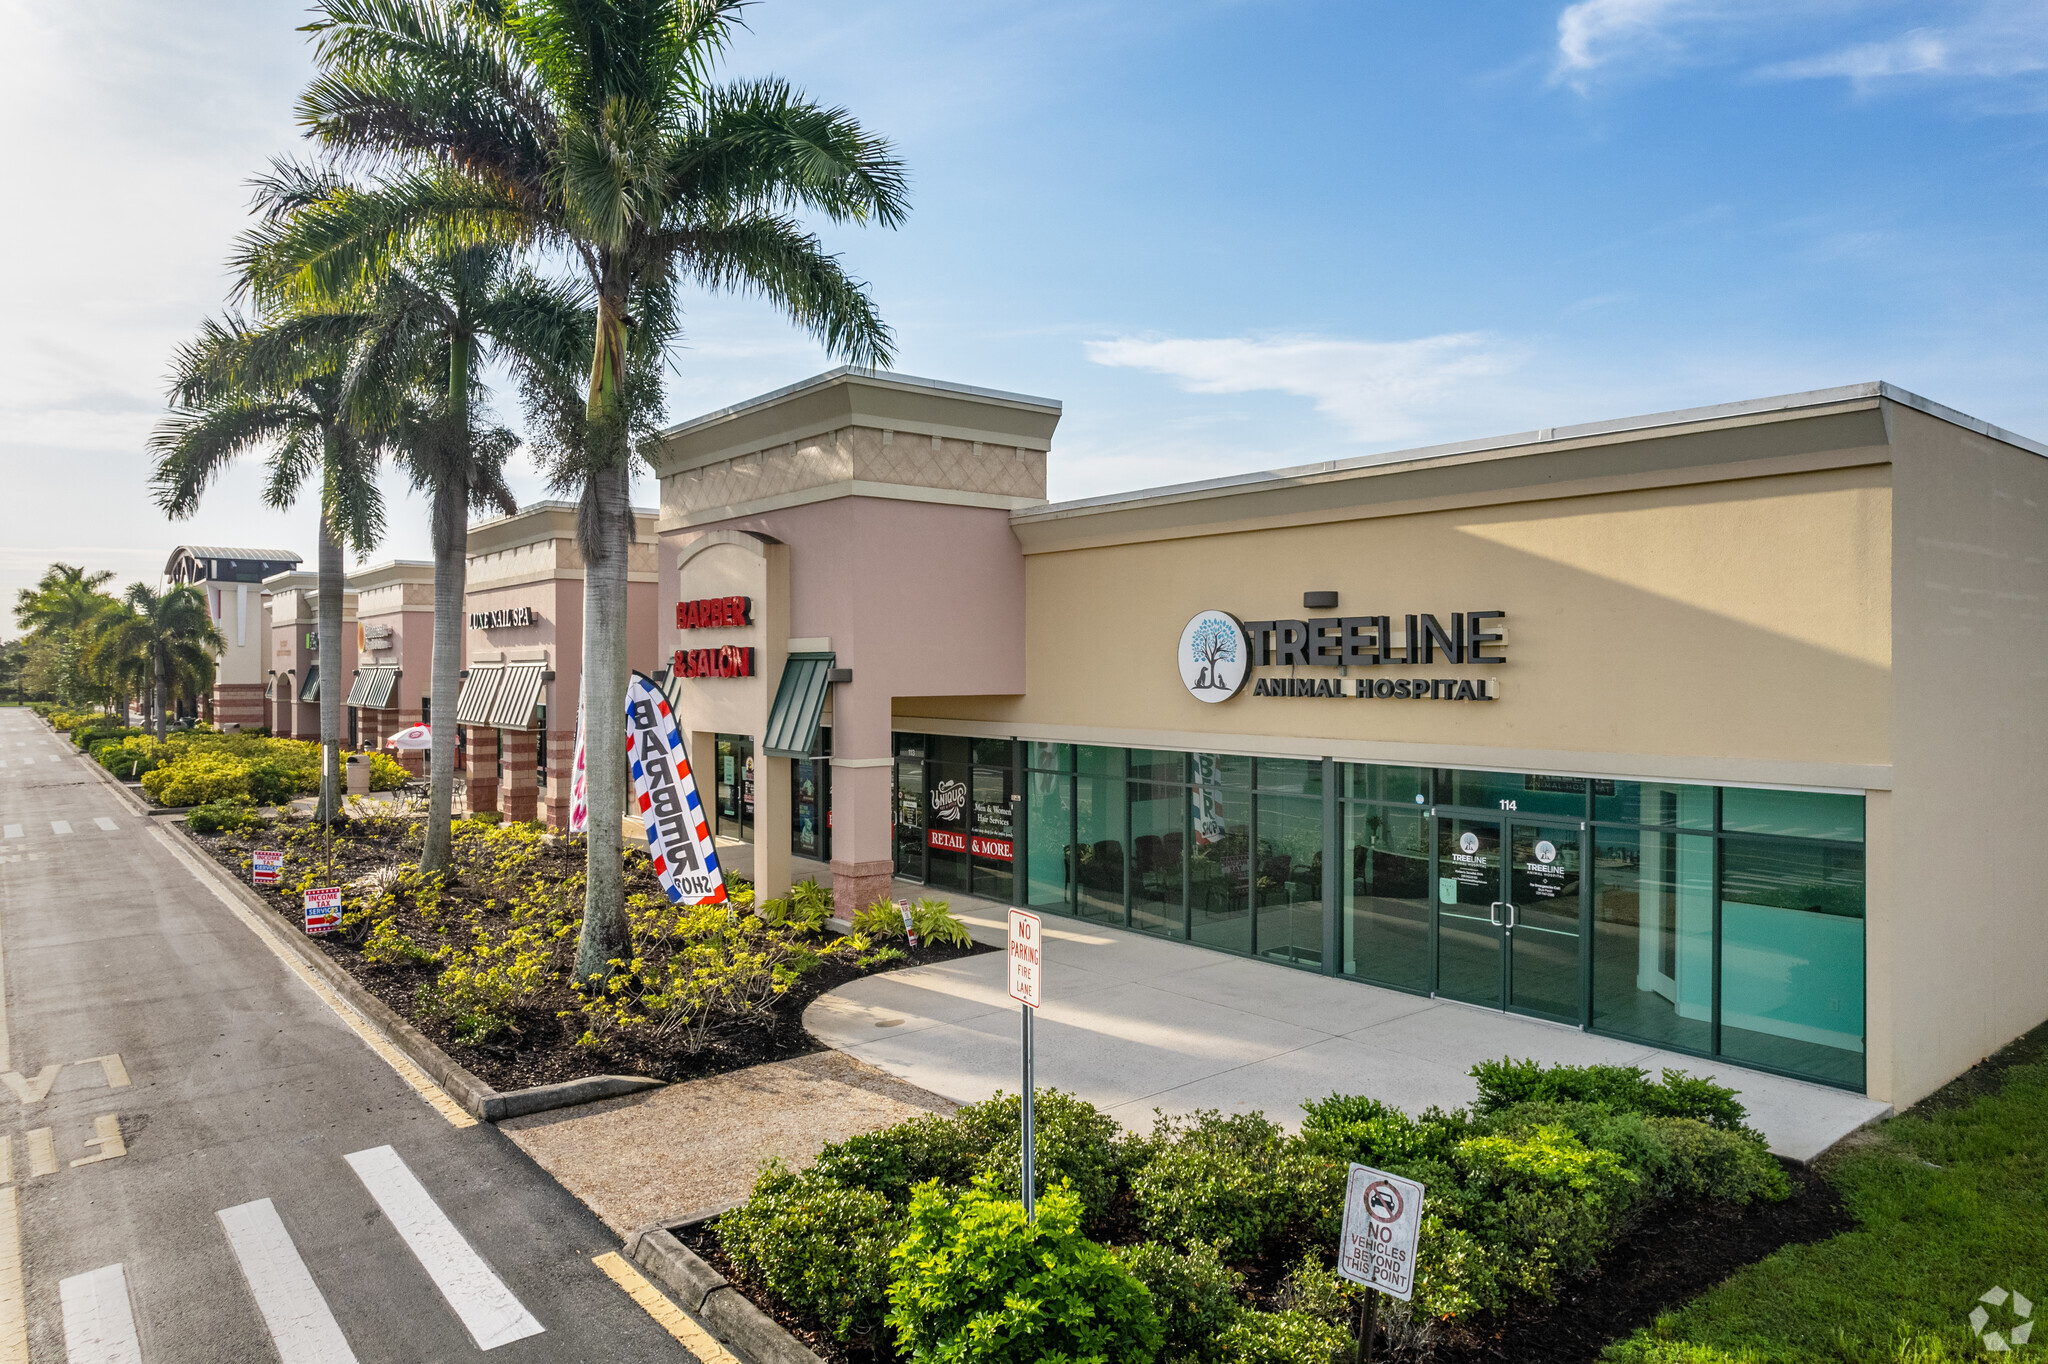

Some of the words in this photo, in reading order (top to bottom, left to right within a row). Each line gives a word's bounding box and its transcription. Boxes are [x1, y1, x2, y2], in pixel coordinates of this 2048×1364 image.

[469, 611, 489, 630] LUXE
[490, 609, 512, 628] NAIL
[512, 606, 531, 626] SPA
[676, 596, 752, 630] BARBER
[1244, 611, 1506, 667] TREELINE
[1253, 678, 1347, 698] ANIMAL
[1355, 679, 1493, 701] HOSPITAL
[930, 782, 967, 810] UNIQUE
[1499, 799, 1518, 811] 114
[975, 803, 986, 812] Men
[987, 805, 993, 813] &
[993, 804, 1012, 816] Women
[977, 813, 988, 823] Hair
[989, 816, 1009, 826] Services
[931, 831, 965, 849] RETAIL
[971, 839, 980, 853] &
[981, 841, 1013, 857] MORE.
[1452, 853, 1487, 865] TREELINE
[1526, 863, 1565, 875] TREELINE
[308, 893, 338, 903] INCOME
[316, 900, 331, 908] TAX
[1018, 921, 1031, 940] NO
[1010, 940, 1039, 966] PARKING
[1017, 964, 1032, 980] FIRE
[1016, 980, 1033, 997] LANE
[1367, 1221, 1393, 1244] NO
[1351, 1233, 1407, 1262] VEHICLES
[1345, 1255, 1370, 1274] THIS
[1373, 1265, 1407, 1287] POINT
[1353, 1247, 1401, 1273] BEYOND
